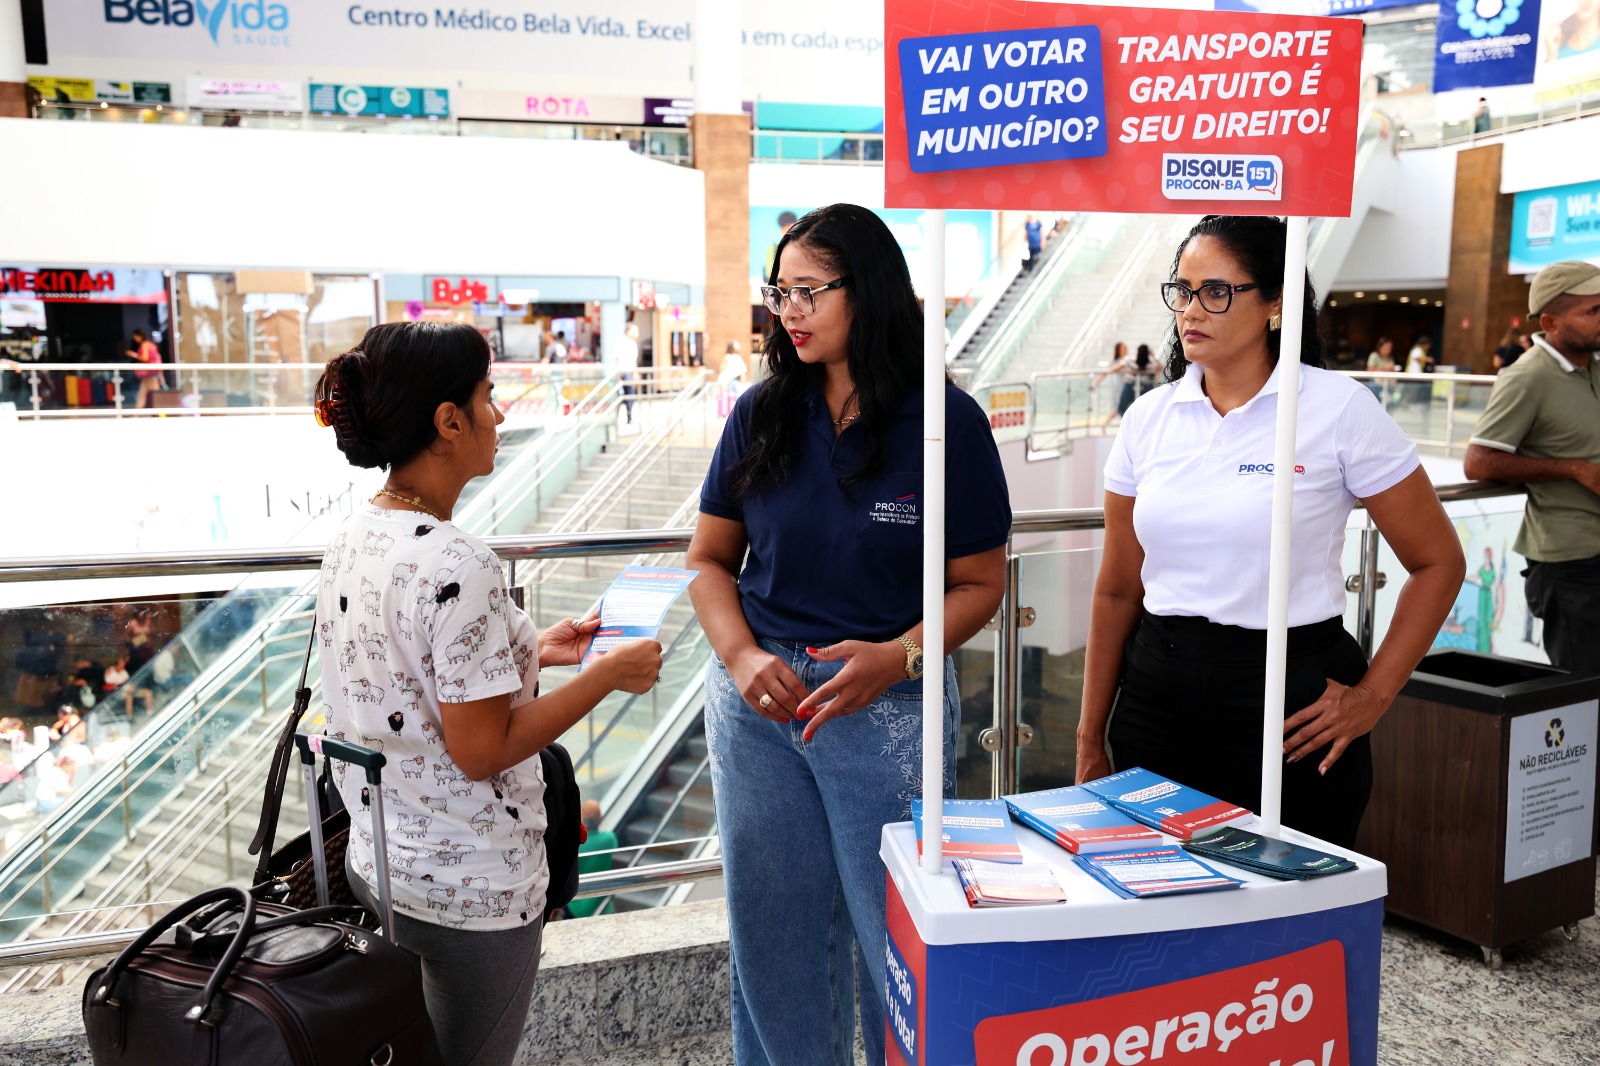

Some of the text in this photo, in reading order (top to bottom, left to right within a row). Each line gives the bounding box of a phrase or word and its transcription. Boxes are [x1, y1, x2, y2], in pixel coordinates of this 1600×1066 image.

[348, 5, 428, 27] Centro
[434, 8, 517, 32] Médico
[523, 13, 571, 35] Bela
[576, 17, 631, 38] Vida.
[636, 20, 692, 41] Excel
[791, 31, 839, 49] cada
[917, 37, 1087, 75] VAI VOTAR
[1117, 30, 1332, 64] TRANSPORTE
[921, 78, 1088, 115] EM OUTRO
[1129, 64, 1323, 104] GRATUITO É
[916, 114, 1100, 156] MUNICÍPIO?
[1119, 107, 1331, 144] SEU DIREITO!
[1166, 159, 1272, 180] DISQUE 151
[1166, 179, 1244, 190] PROCON-BA
[1238, 463, 1275, 473] PROC
[875, 502, 916, 513] PROCON
[1519, 755, 1536, 771] NÃO
[1537, 744, 1587, 766] RECICLÁVEIS
[886, 933, 912, 1006] peração
[895, 999, 915, 1056] Vota!
[1016, 977, 1314, 1066] Operação
